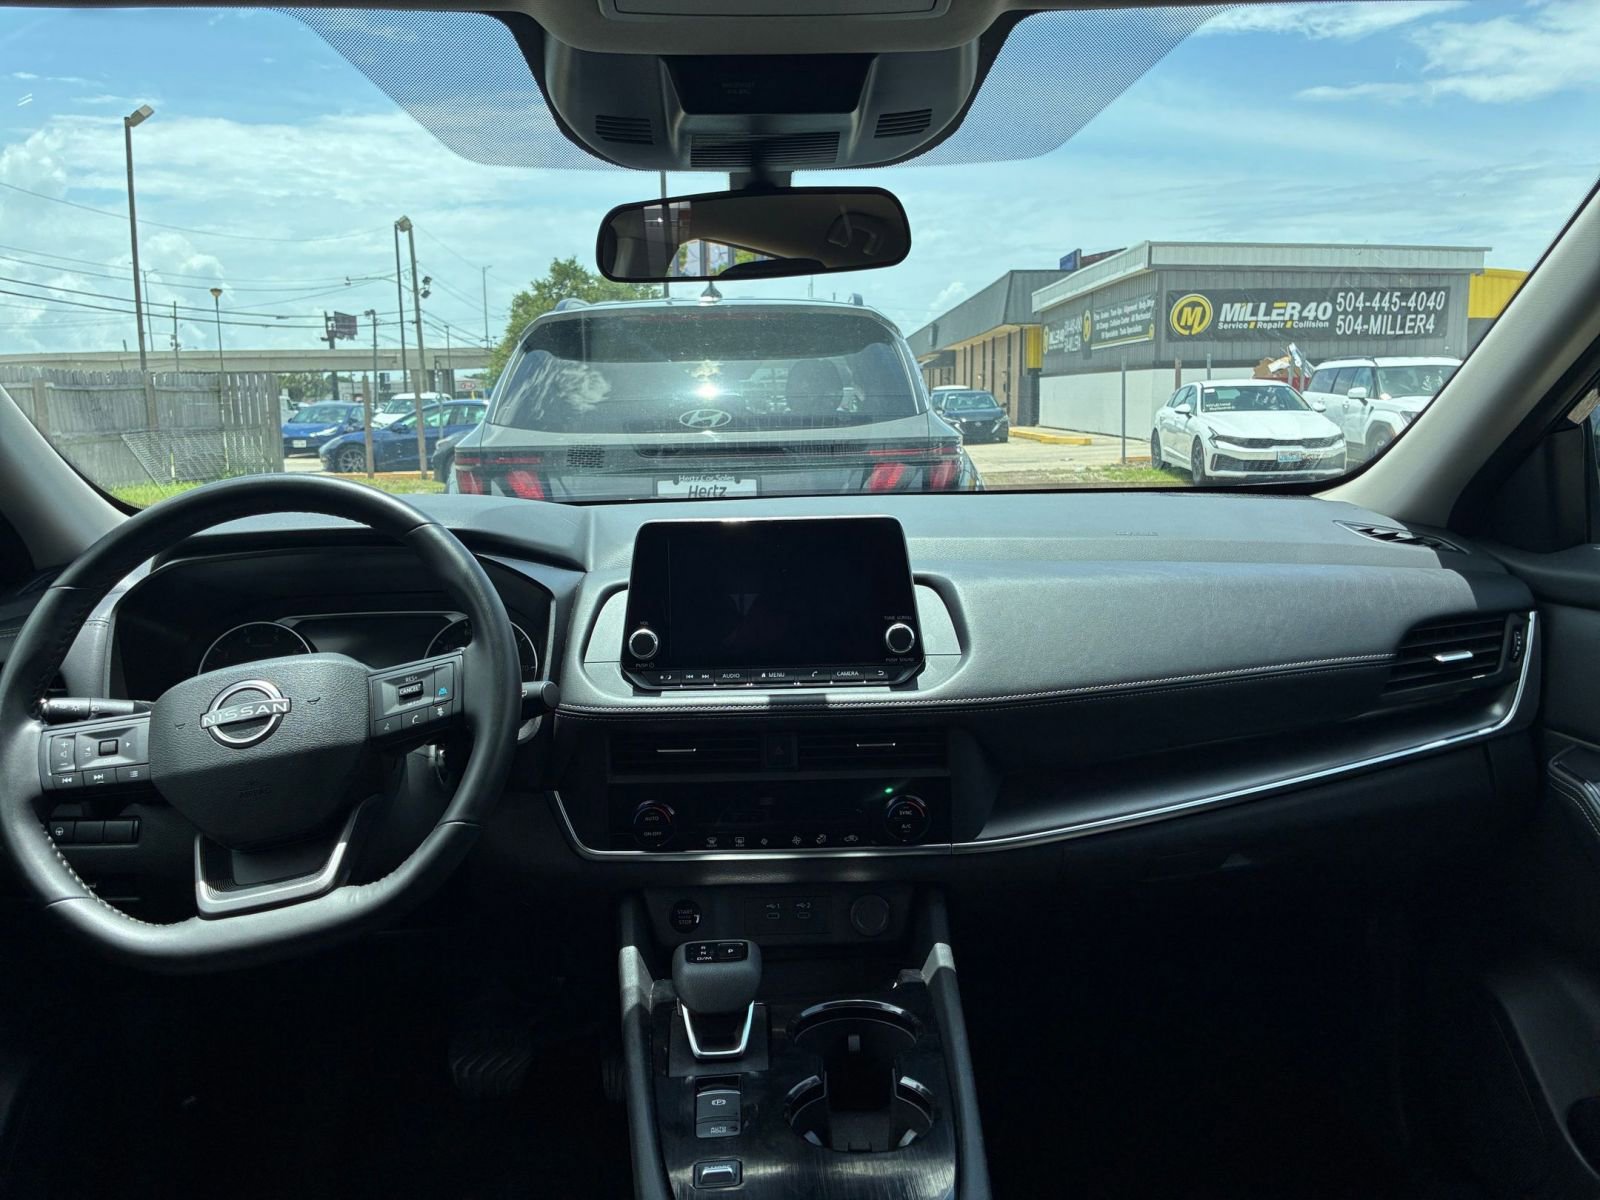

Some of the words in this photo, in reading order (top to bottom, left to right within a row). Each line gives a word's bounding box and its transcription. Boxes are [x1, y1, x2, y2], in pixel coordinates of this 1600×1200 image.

[1302, 301, 1333, 321] 40
[1336, 291, 1446, 312] 504-445-4040
[1218, 321, 1248, 329] Service
[1257, 321, 1284, 330] Repair
[1293, 320, 1329, 328] Collision
[1336, 313, 1435, 335] 504-MILLER4
[688, 484, 727, 498] Hertz
[399, 685, 420, 695] CANCEL
[203, 703, 288, 727] NISSAN
